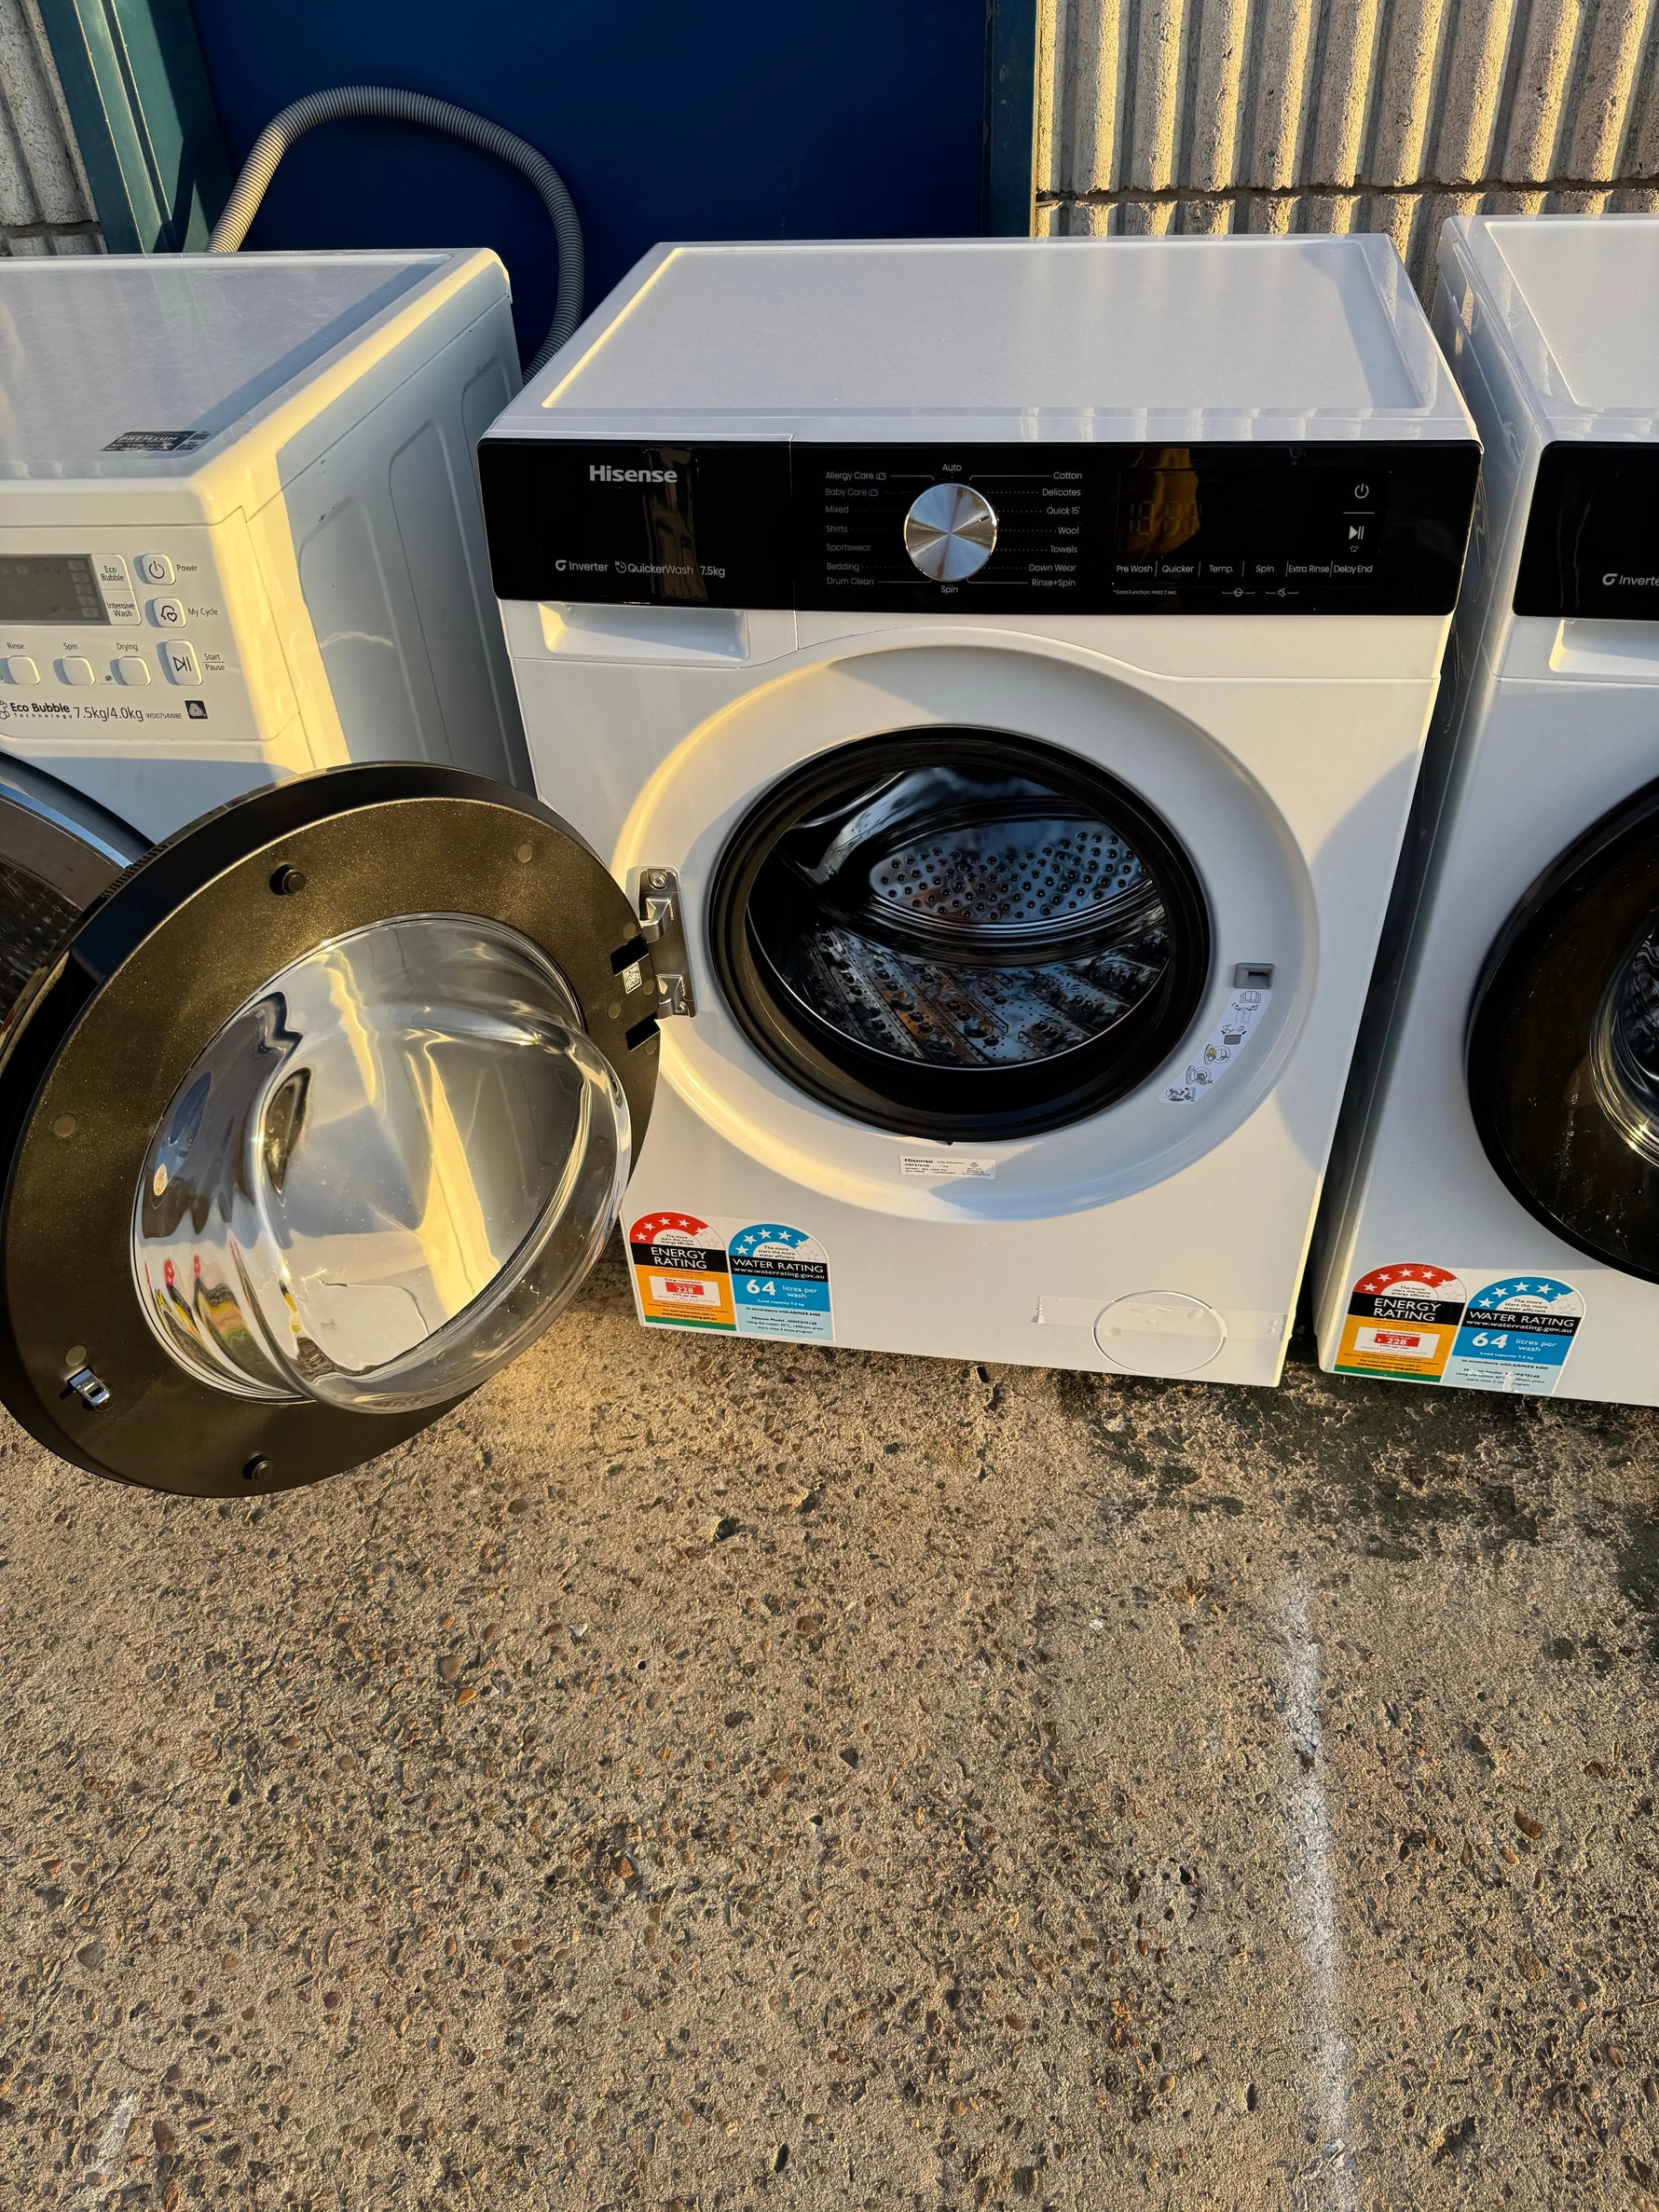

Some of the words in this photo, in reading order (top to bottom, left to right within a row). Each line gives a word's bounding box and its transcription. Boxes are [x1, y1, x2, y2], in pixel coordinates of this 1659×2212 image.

[942, 463, 962, 472] Auto
[589, 465, 677, 483] Hisense
[826, 472, 852, 481] Allergy
[854, 472, 874, 480] Care
[1052, 472, 1082, 480] Cotton
[826, 488, 846, 498] Baby
[826, 505, 849, 514] Mixed
[1046, 507, 1070, 516] Quick
[826, 525, 848, 533] Shirts
[1058, 526, 1079, 535] Wool
[826, 543, 871, 553] Sportswear
[1049, 545, 1077, 554] Towels
[569, 561, 609, 572] Inverter
[628, 563, 693, 575] QuickerWash
[700, 565, 726, 578] 7.5kg
[827, 563, 859, 572] Bedding
[1029, 563, 1049, 571] Down
[1051, 563, 1076, 571] Wear
[1117, 565, 1129, 573] Pre
[1130, 565, 1153, 573] Wash
[1161, 565, 1194, 573] Quicker
[1209, 565, 1234, 574] Temp.
[1256, 565, 1274, 574] Spin
[1288, 565, 1307, 573] Extra
[1309, 565, 1330, 573] Rinse
[1333, 565, 1357, 575] Delay
[1357, 565, 1373, 573] End
[101, 573, 125, 582] Bubble
[827, 577, 848, 585] Drum
[850, 577, 874, 585] Clean
[1031, 578, 1076, 588] Rinse+Spin
[941, 584, 958, 595] Spin
[188, 608, 199, 616] My
[199, 608, 218, 616] Cycle
[63, 642, 78, 651] Spin
[117, 642, 138, 652] Drying
[9, 703, 29, 712] Eco
[32, 703, 71, 713] Bubble
[74, 707, 144, 721] 7.5kg/4.0kg
[651, 1247, 706, 1259] ENERGY
[654, 1256, 707, 1270] RATING
[733, 1258, 774, 1269] WATER
[777, 1262, 824, 1273] RATING
[734, 1267, 825, 1280] www.waterrating.gov.au
[747, 1279, 775, 1296] 64
[804, 1287, 817, 1296] per
[1374, 1298, 1441, 1311] ENERGY
[1373, 1308, 1436, 1321] RATING
[1470, 1311, 1515, 1322] WATER
[1521, 1316, 1575, 1327] RATING
[1466, 1320, 1572, 1333] www.waterrating.gov.au
[1473, 1332, 1508, 1349] 64
